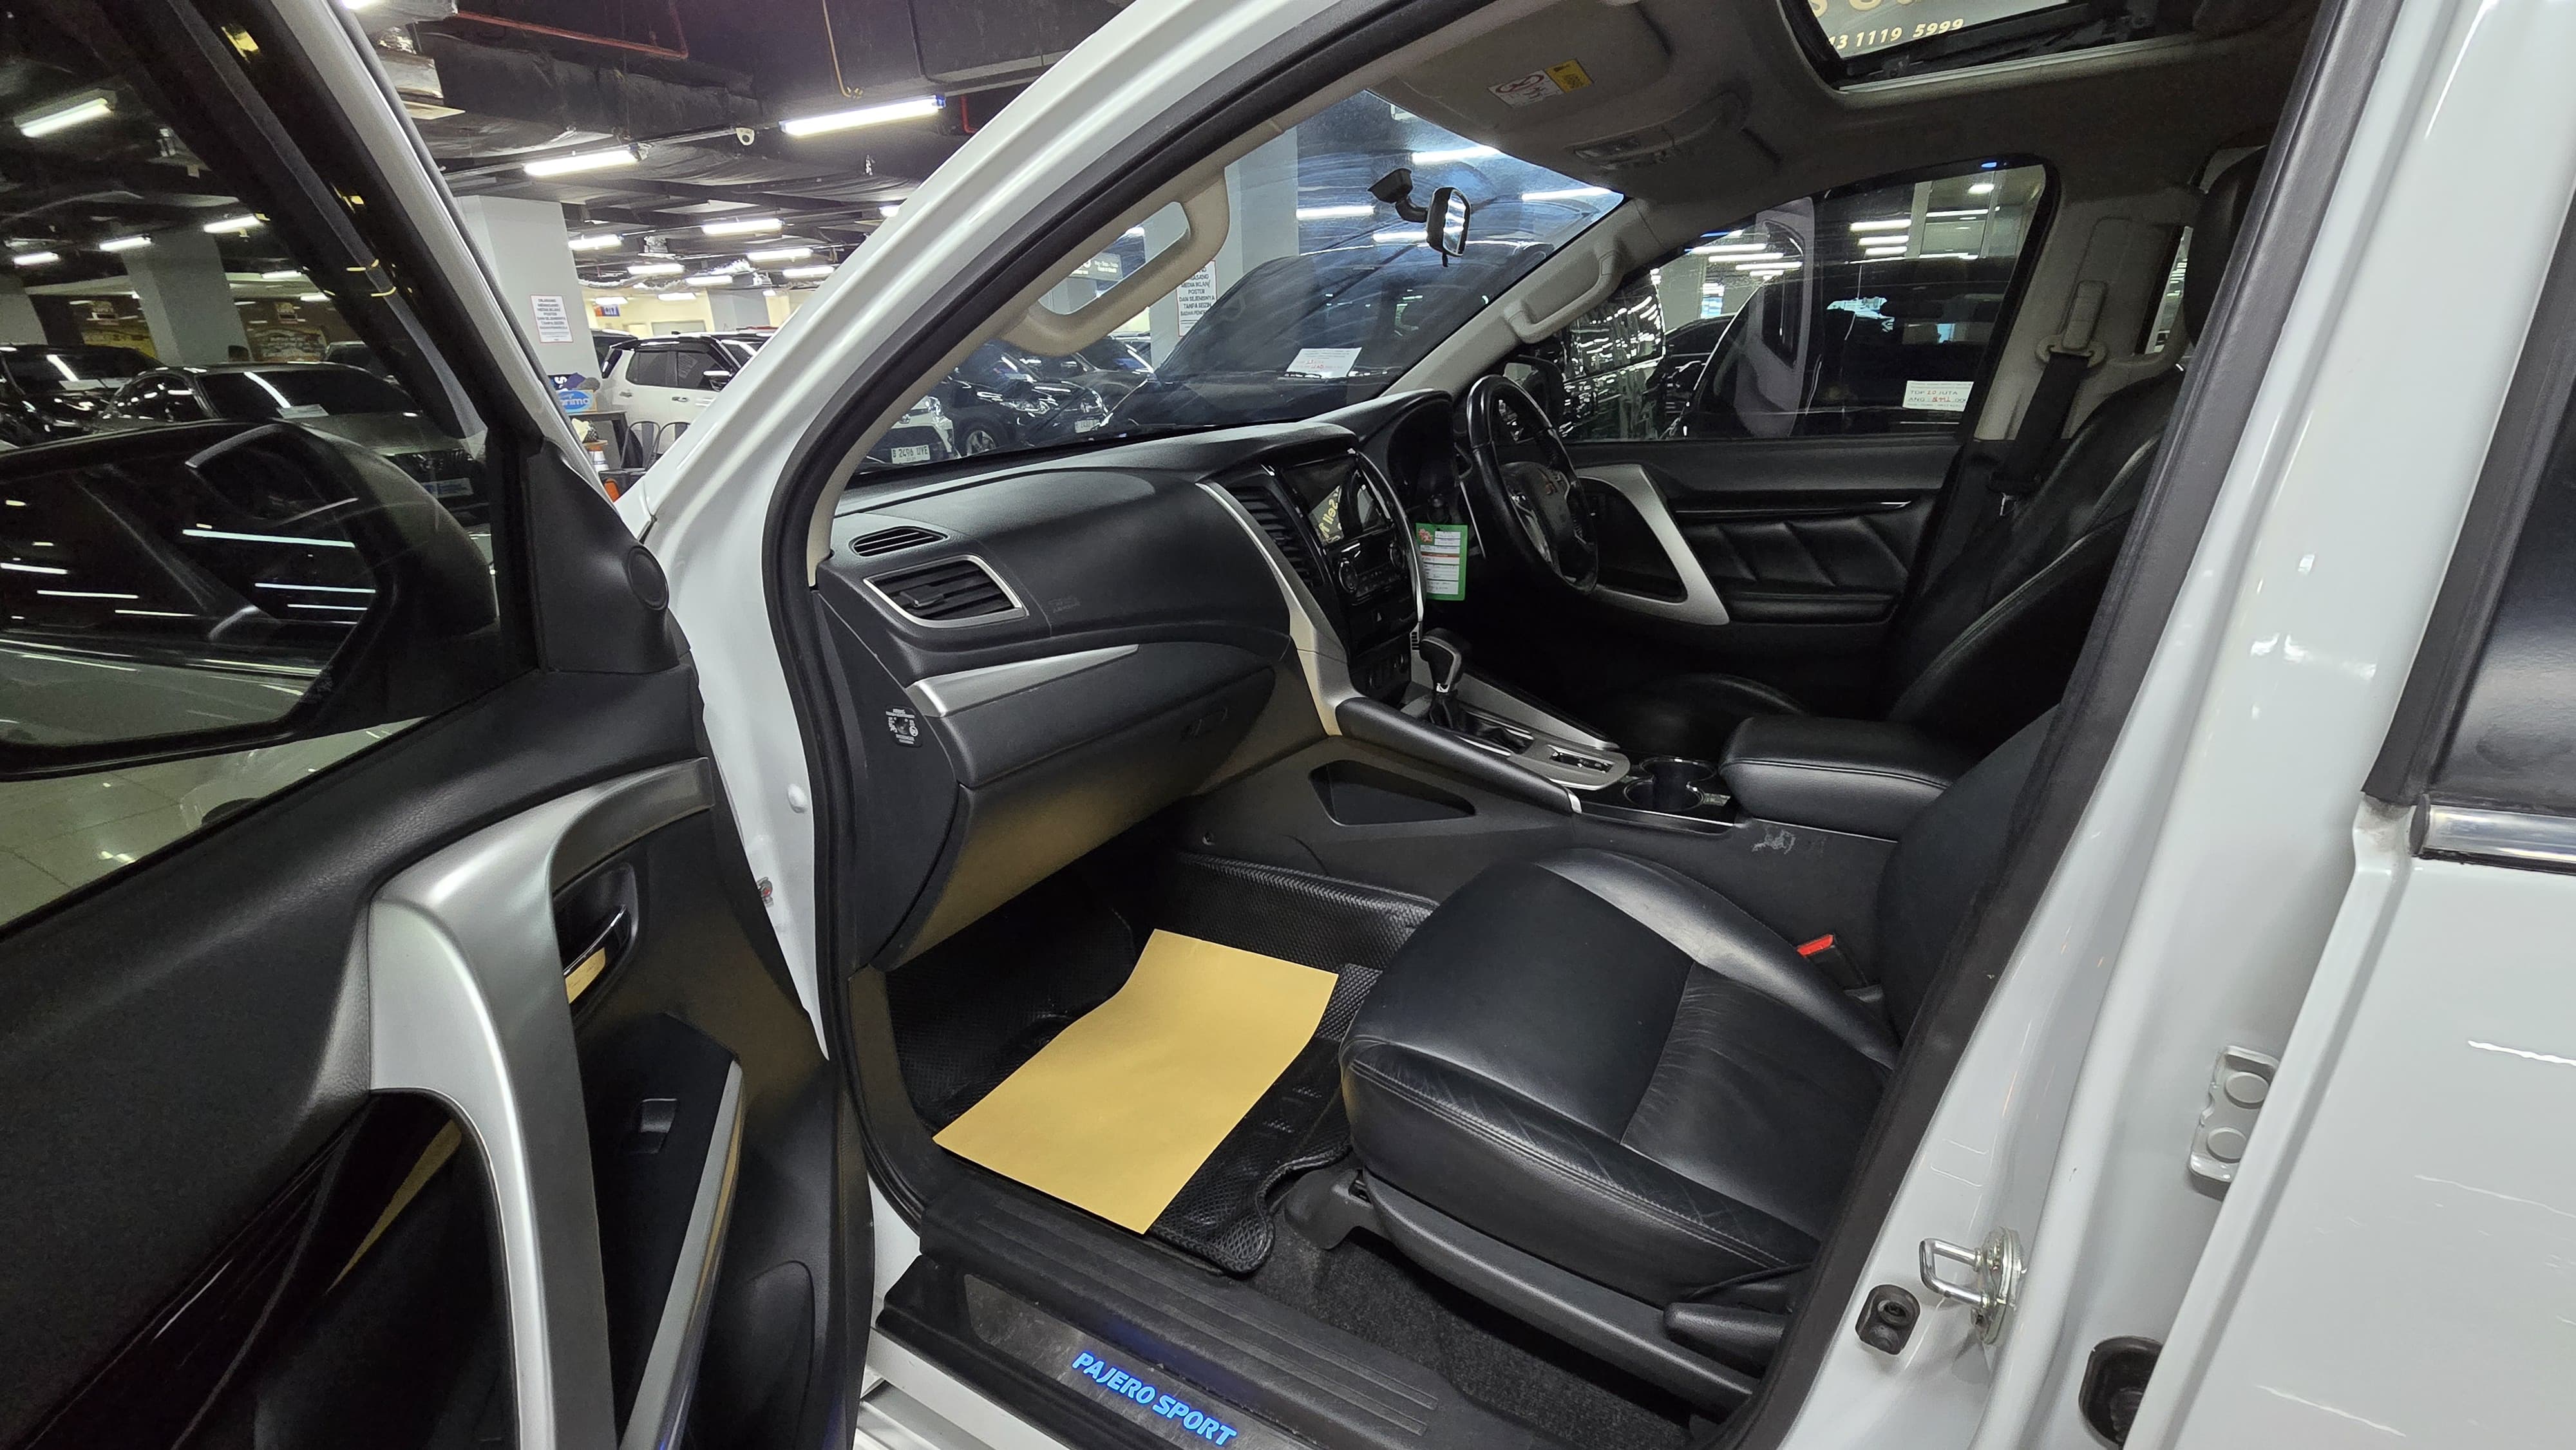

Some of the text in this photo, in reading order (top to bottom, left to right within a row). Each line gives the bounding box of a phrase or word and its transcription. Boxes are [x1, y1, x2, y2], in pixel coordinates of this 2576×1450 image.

[1829, 19, 1964, 50] 13 1119 5999
[1072, 1352, 1238, 1446] PAJERO SPORT
